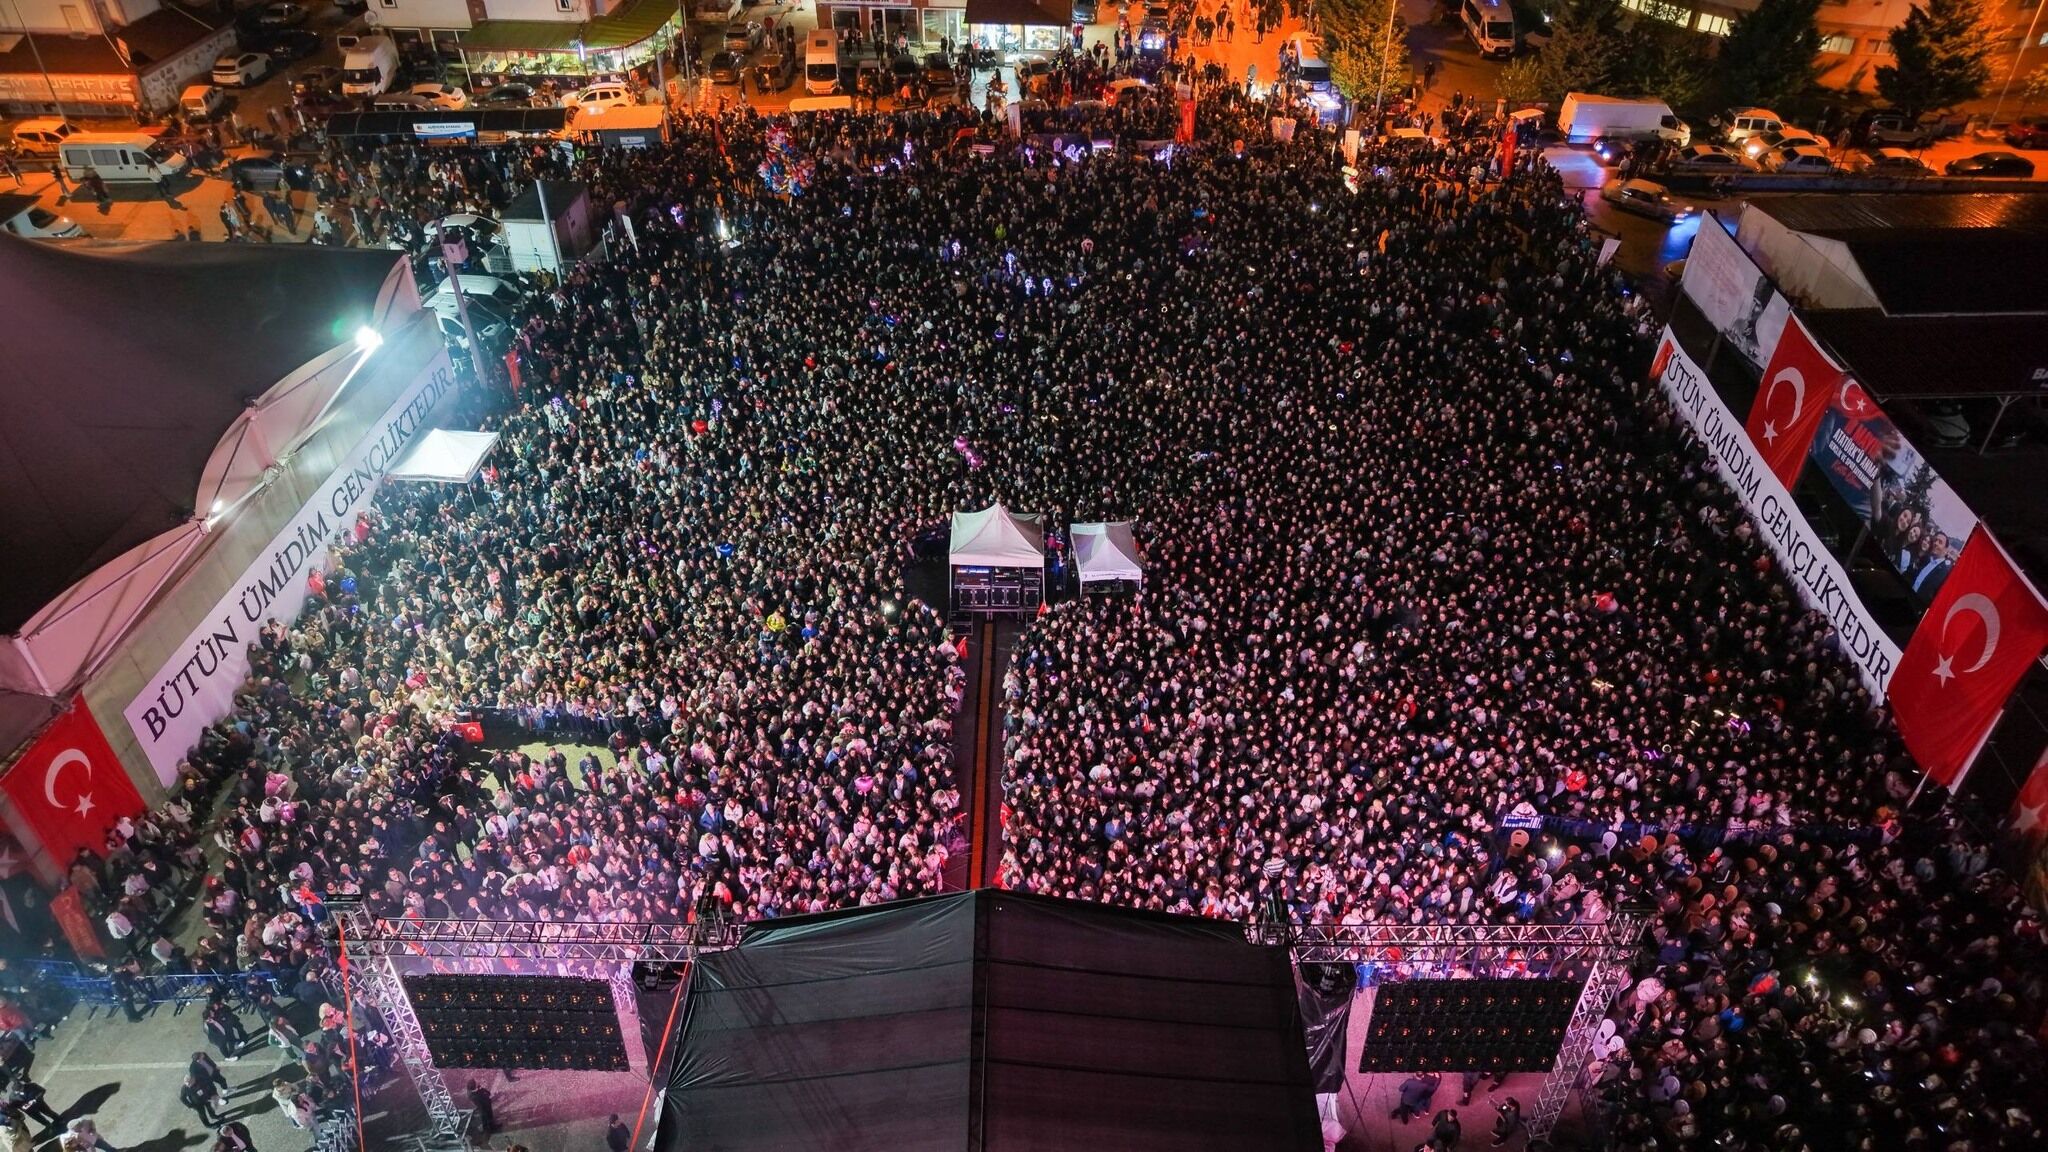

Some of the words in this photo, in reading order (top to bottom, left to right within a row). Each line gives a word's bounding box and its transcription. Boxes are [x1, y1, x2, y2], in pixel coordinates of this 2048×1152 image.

[141, 616, 240, 742] BÜTÜN
[238, 510, 331, 623] ÜMİDİM
[330, 365, 454, 518] GENÇLİKTEDİR
[1667, 353, 1707, 420] ÜTÜN
[1703, 407, 1762, 505] ÜMİDİM
[1760, 494, 1892, 693] GENÇLİKTEDİR
